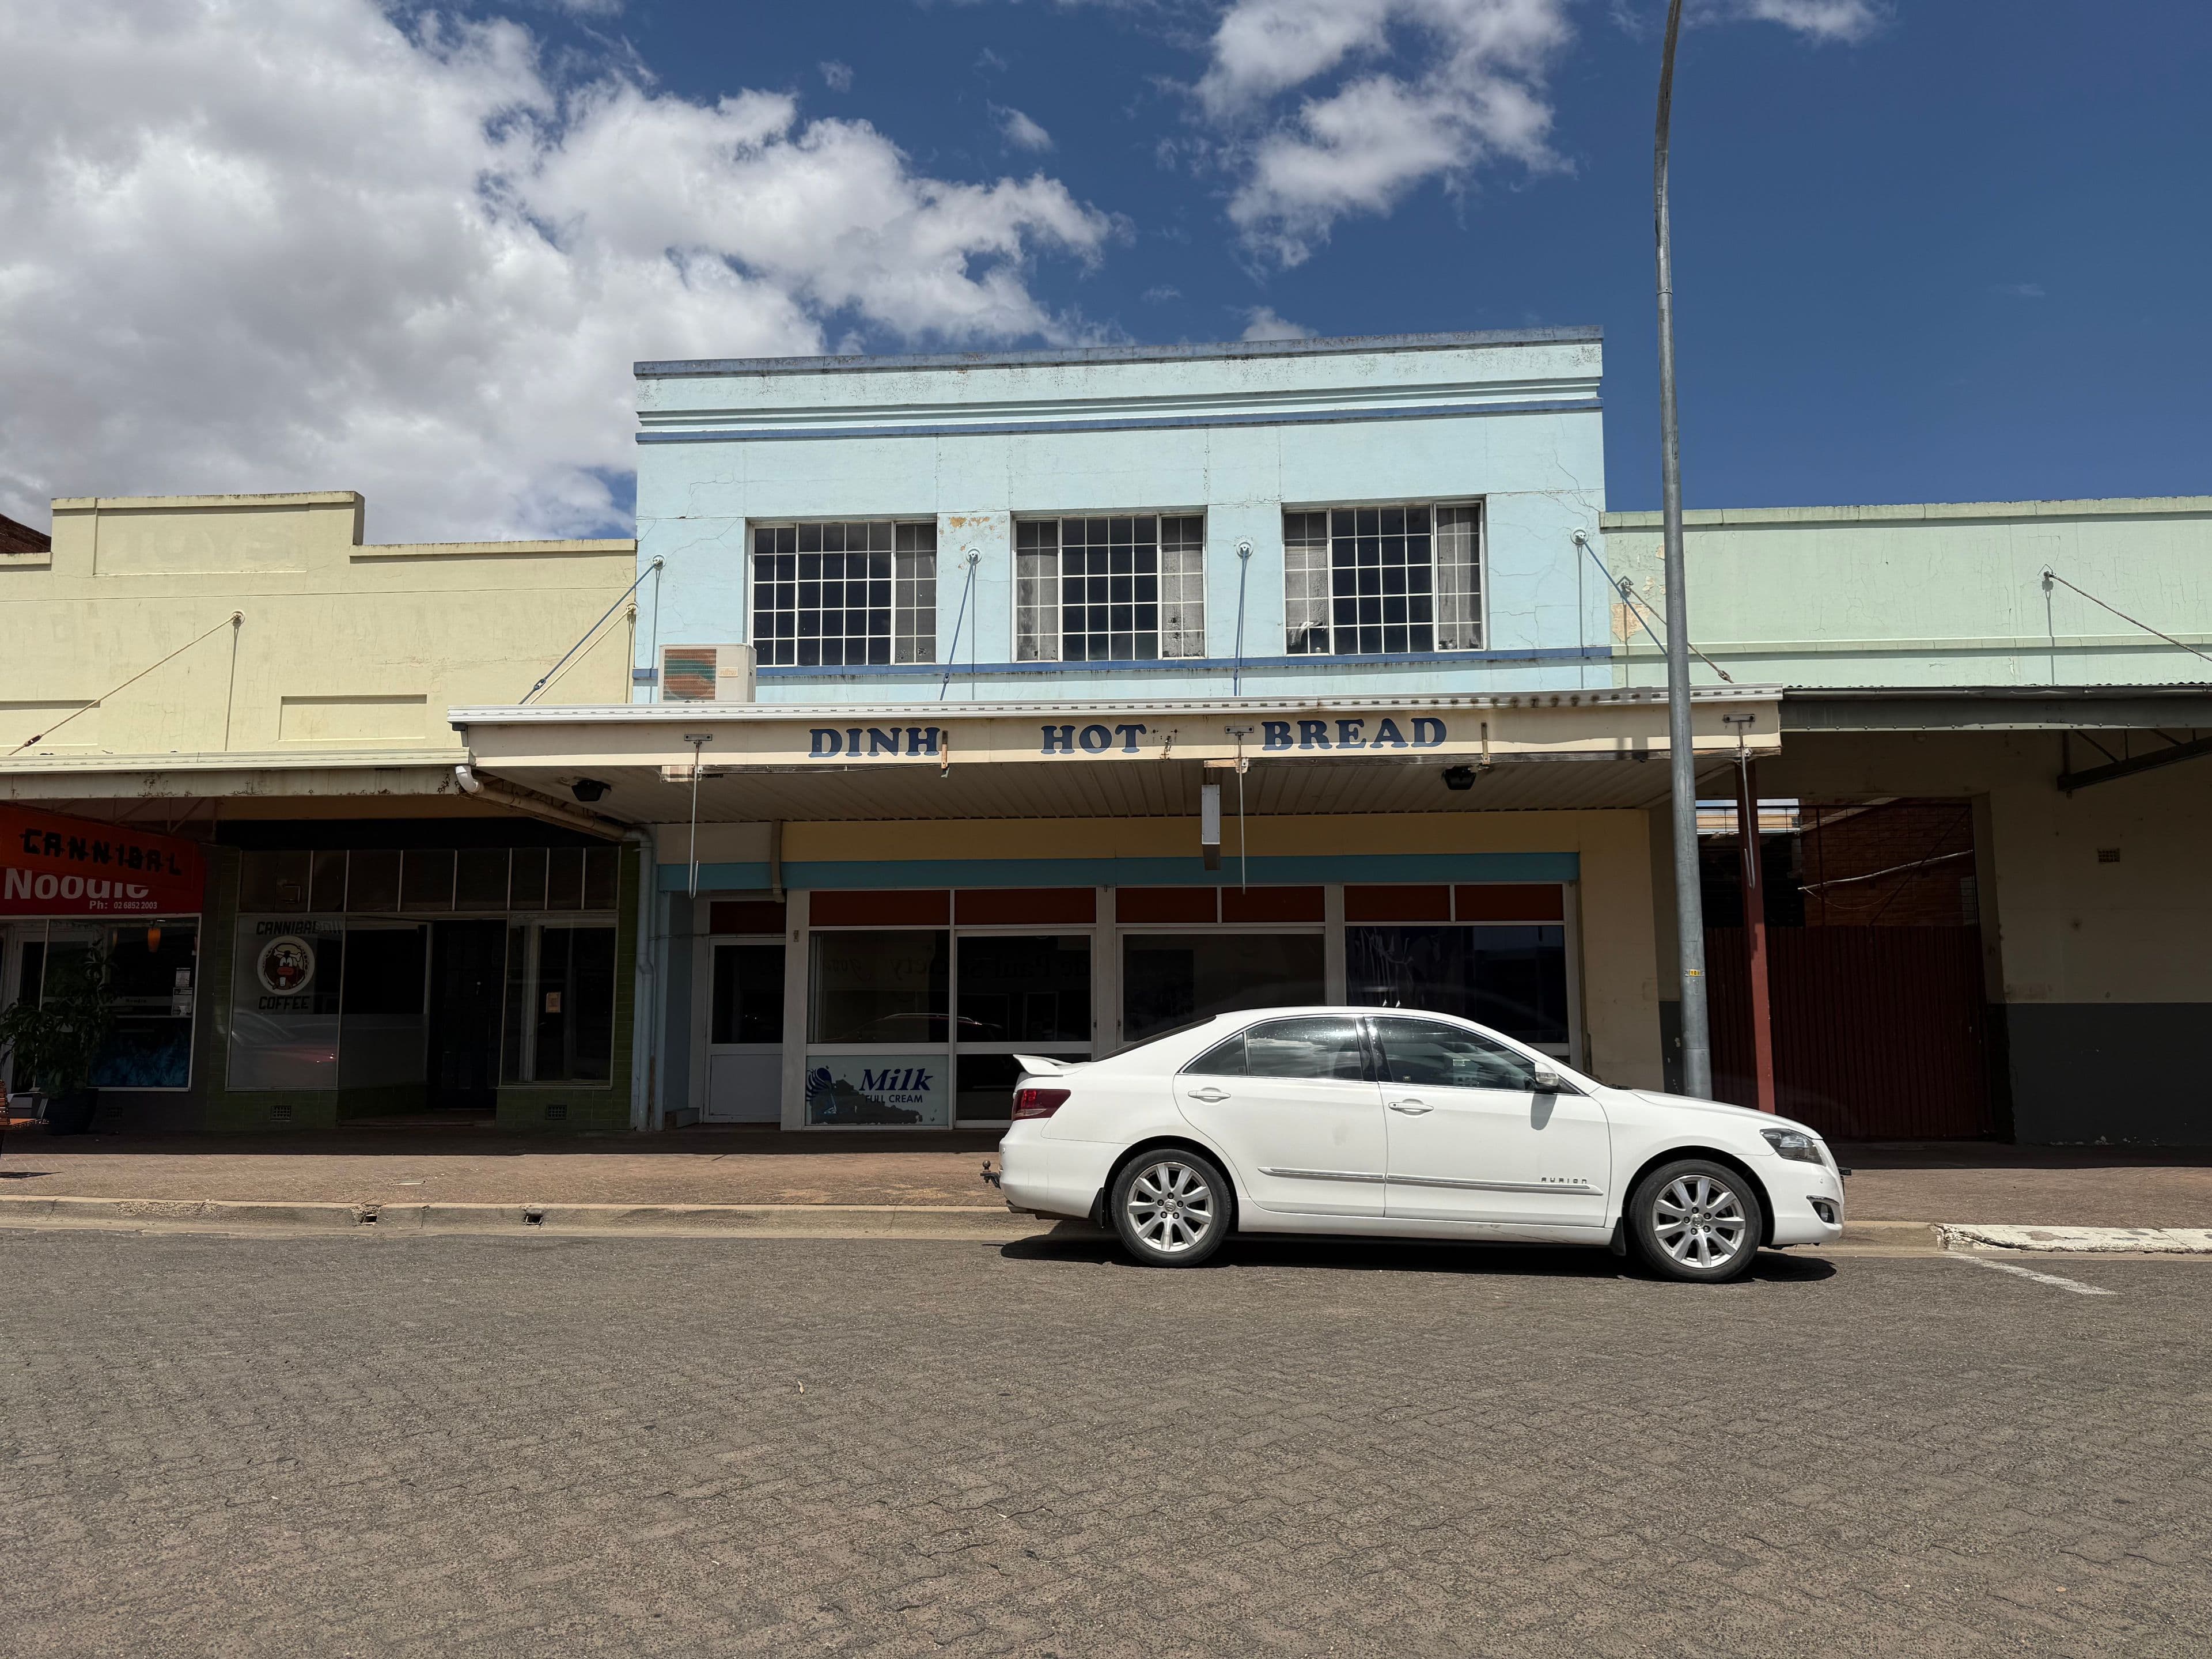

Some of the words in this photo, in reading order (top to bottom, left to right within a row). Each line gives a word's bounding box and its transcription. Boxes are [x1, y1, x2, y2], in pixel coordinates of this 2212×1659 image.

[808, 727, 940, 758] DINH
[1040, 724, 1147, 755] HOT
[1261, 717, 1447, 751] BREAD
[20, 828, 181, 876] CANNIBAL
[89, 900, 108, 910] Ph:
[113, 902, 123, 910] 02
[123, 902, 139, 910] 6852
[141, 902, 157, 910] 2003
[256, 921, 320, 935] CANNIBAL
[258, 995, 310, 1010] COFFEE
[859, 1068, 933, 1090] Milk
[866, 1094, 885, 1103] FULL
[889, 1094, 923, 1103] CREAM
